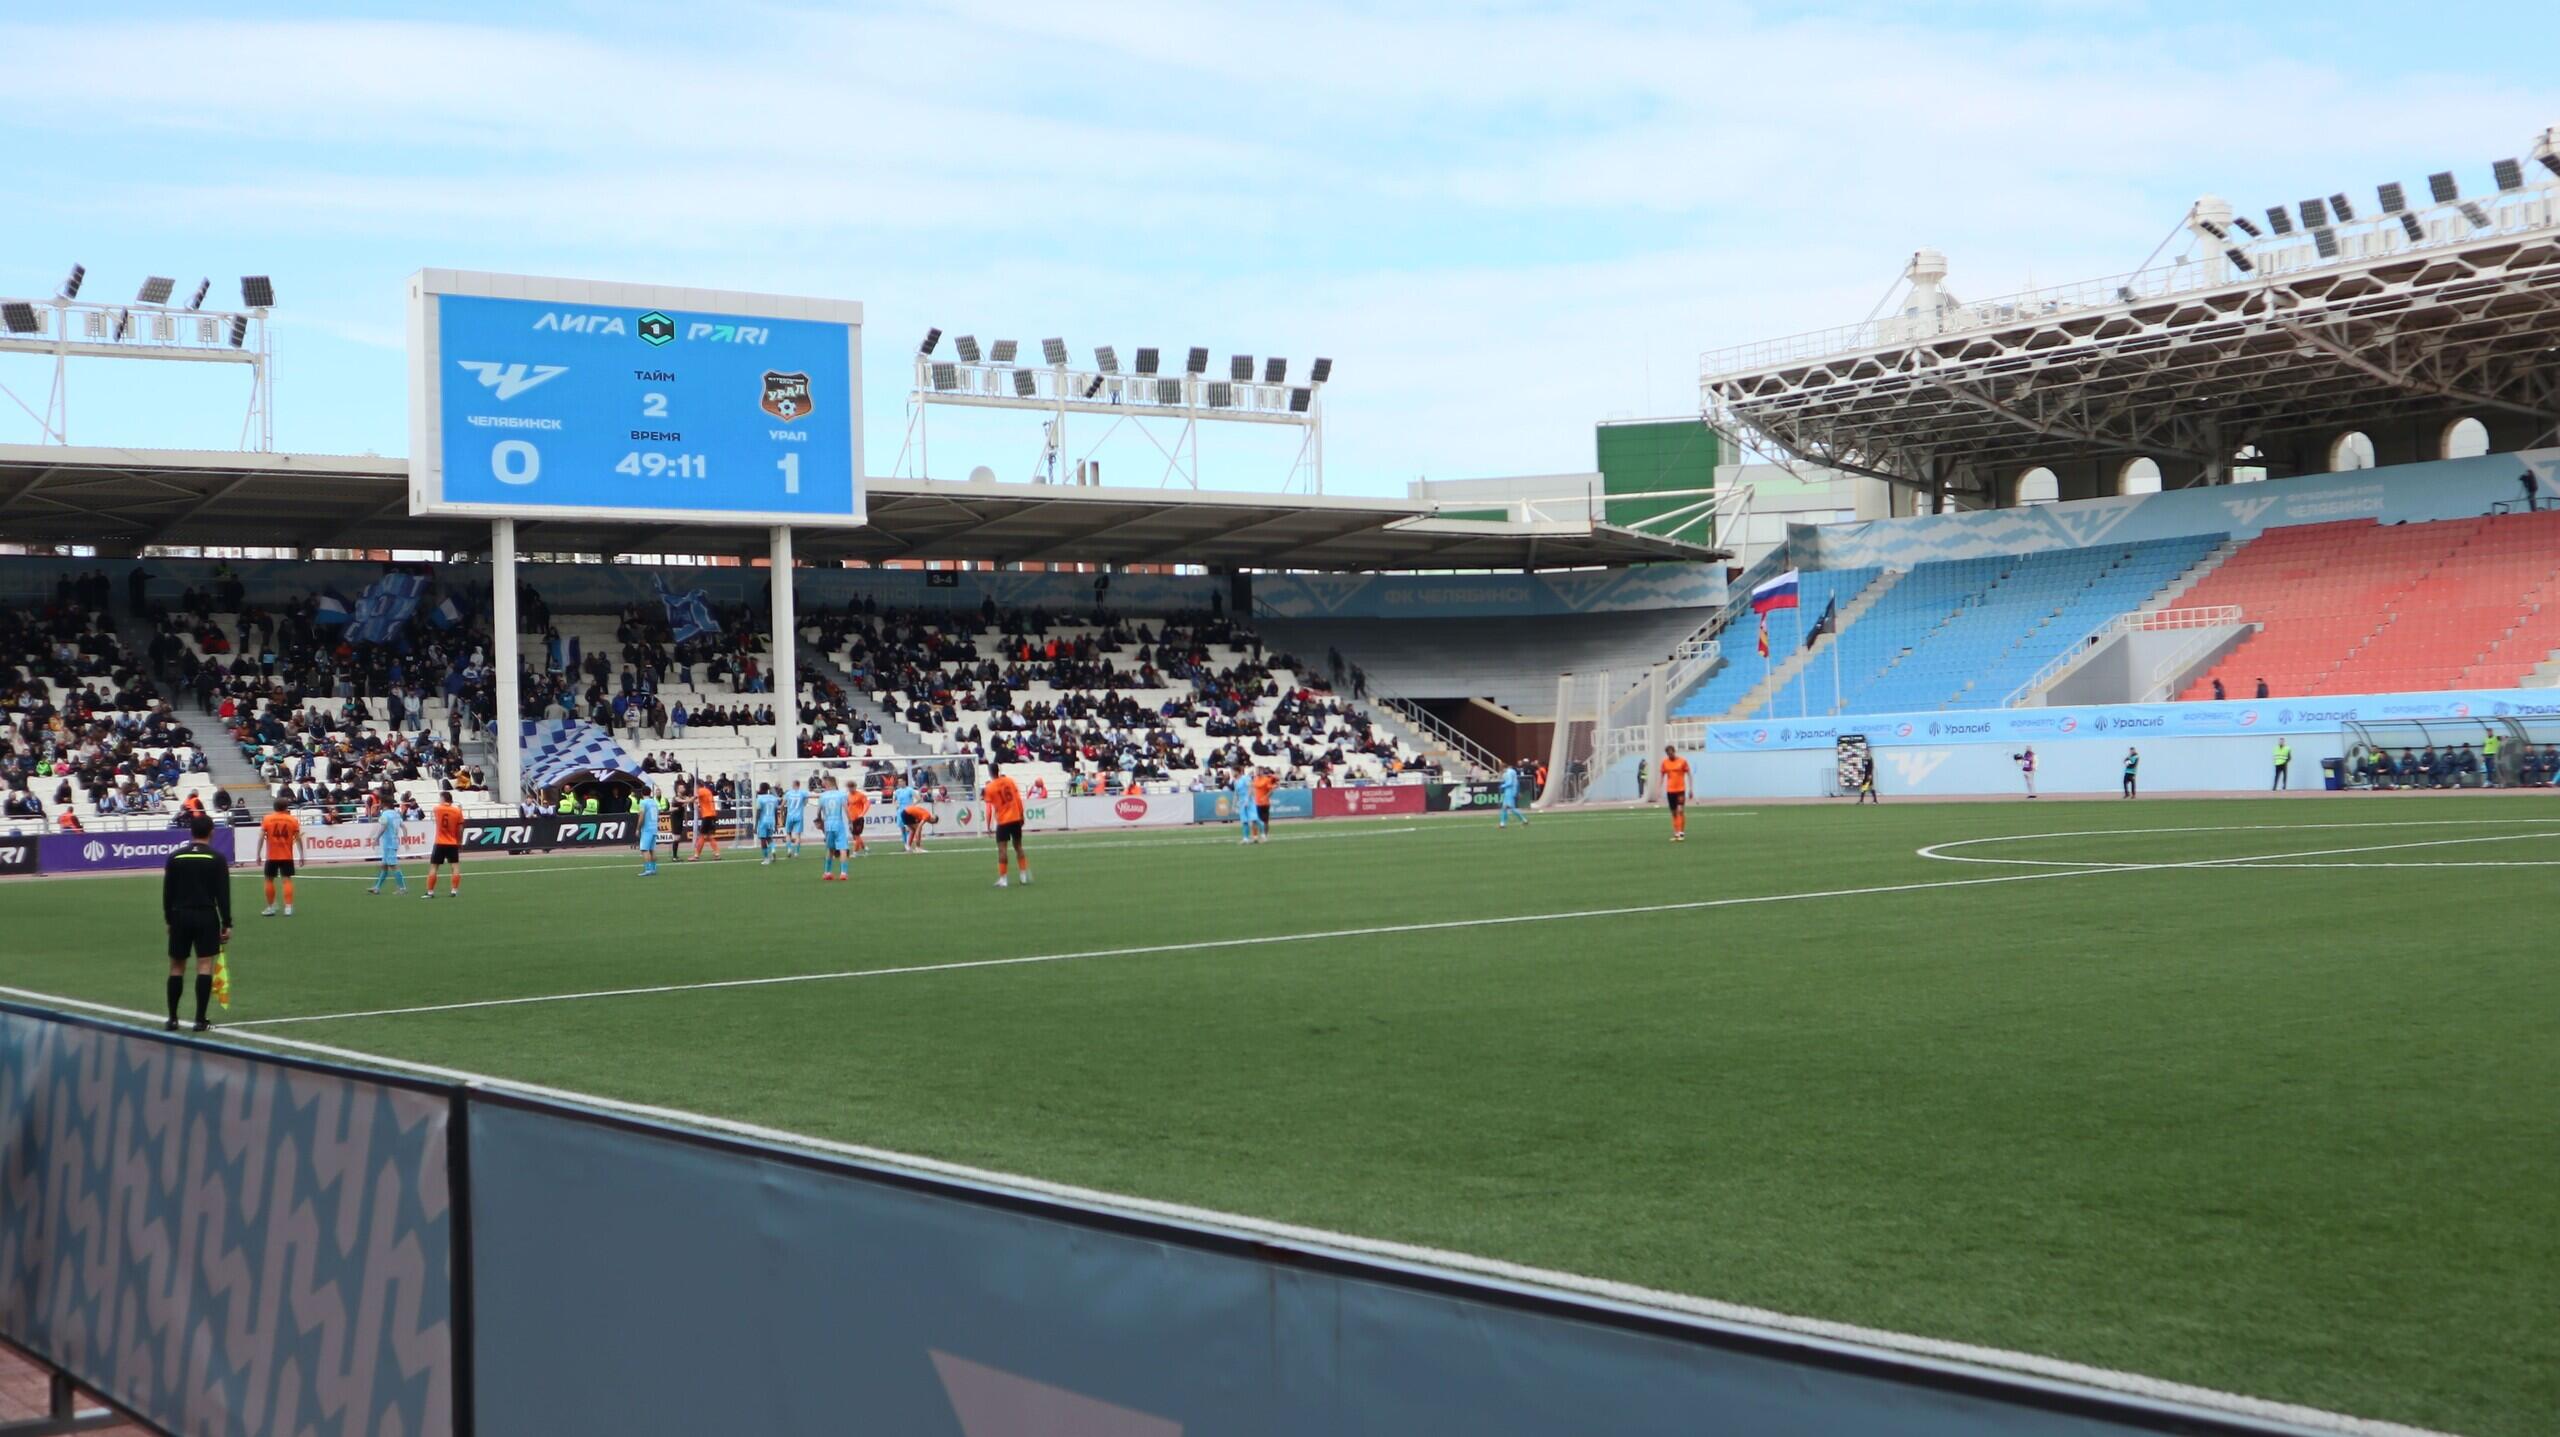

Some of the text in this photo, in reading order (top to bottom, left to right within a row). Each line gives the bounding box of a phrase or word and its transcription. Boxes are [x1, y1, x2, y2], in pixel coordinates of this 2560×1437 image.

[533, 312, 626, 335] ЛИГА
[687, 322, 769, 345] PARI
[634, 369, 676, 382] ТАЙМ
[768, 384, 805, 401] УРАЛ
[642, 392, 668, 418] 2
[467, 415, 562, 430] ЧЕЛЯБИНСК
[630, 430, 681, 442] ВРЕМЯ
[769, 429, 807, 441] УРАЛ
[491, 440, 540, 485] 0
[615, 451, 706, 478] 49:11
[777, 452, 800, 494] 1
[932, 574, 953, 585] 3-4
[1384, 587, 1530, 603] ФК ЧЕЛЯБИНСК
[2113, 715, 2165, 729] Уралсиб
[2299, 709, 2358, 723] Уралсиб
[1795, 727, 1837, 740] Уралсиб
[1945, 722, 1991, 736] Уралсиб
[272, 823, 289, 840] 44
[463, 825, 532, 845] PARI
[557, 822, 626, 843] PARI
[306, 837, 361, 850] Победа
